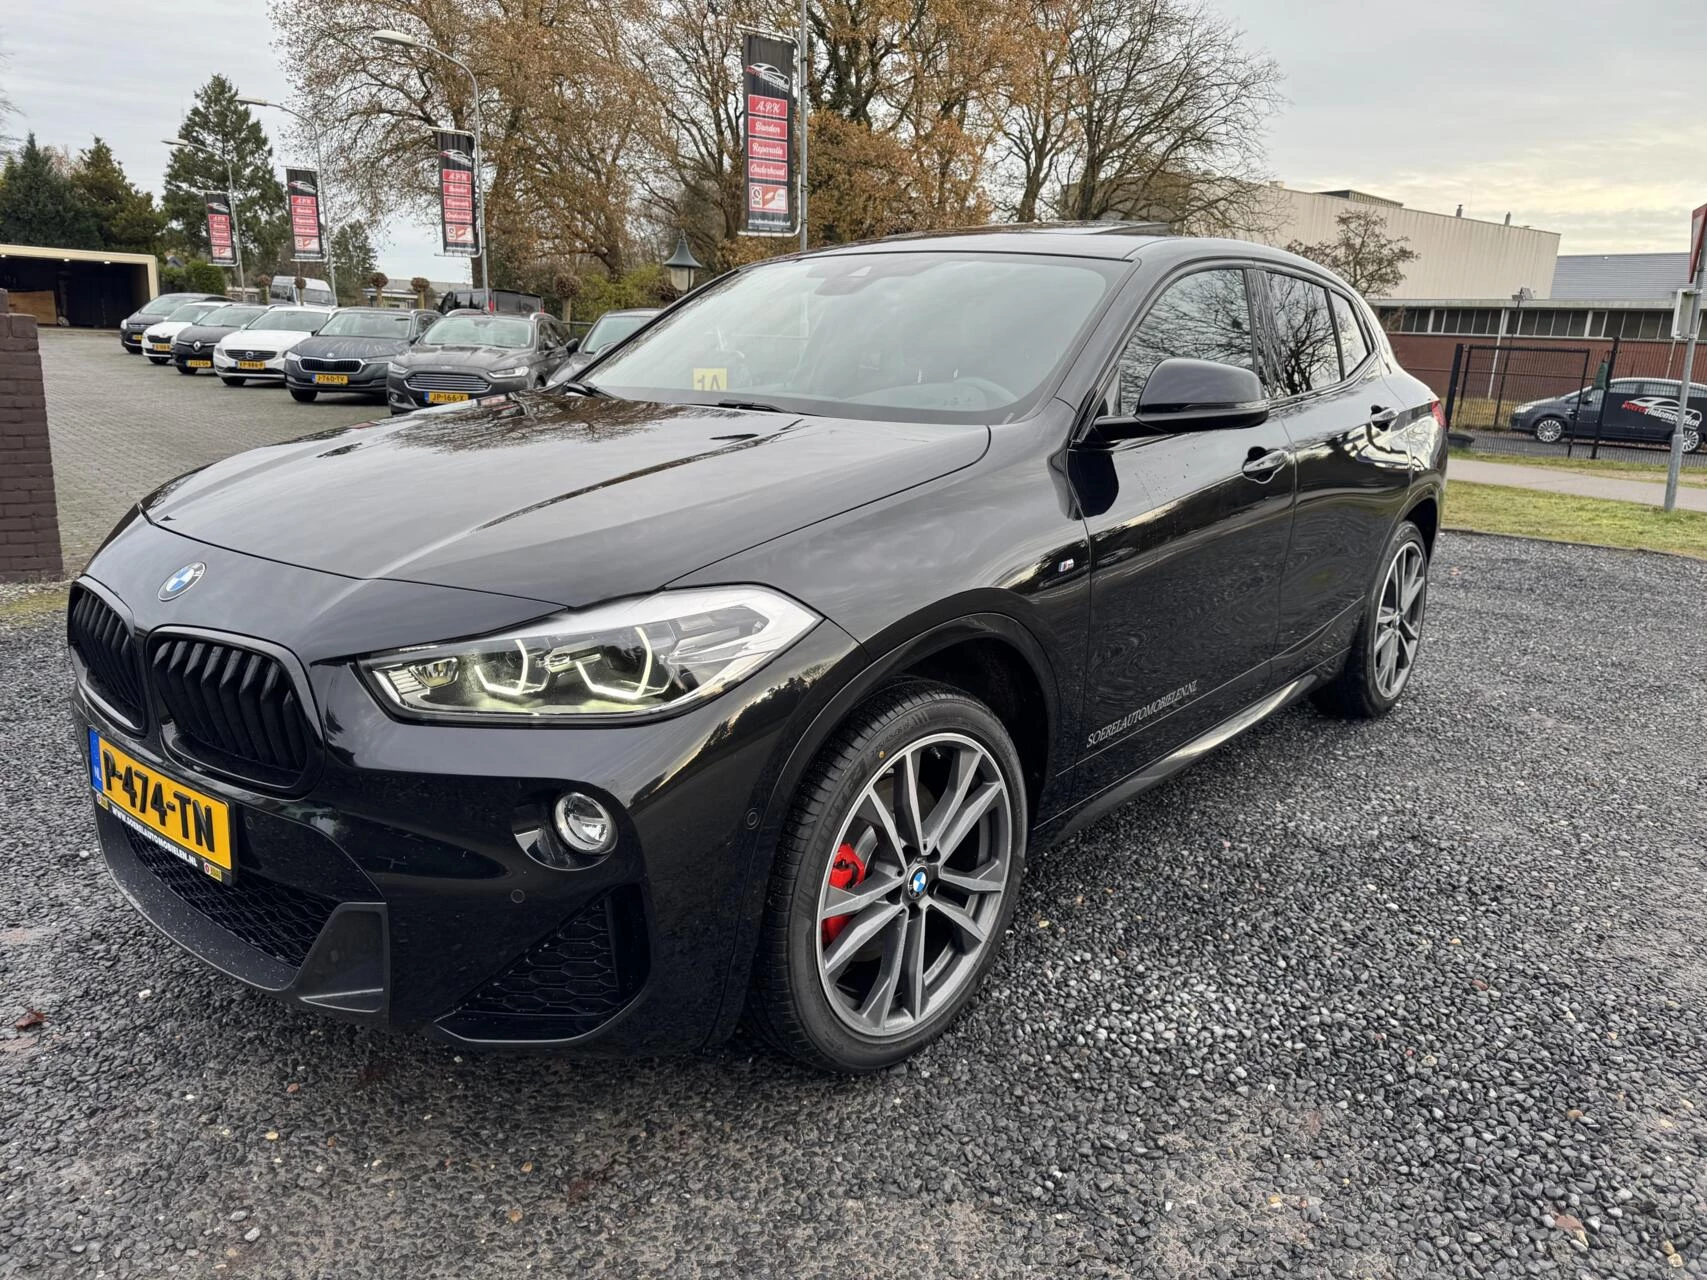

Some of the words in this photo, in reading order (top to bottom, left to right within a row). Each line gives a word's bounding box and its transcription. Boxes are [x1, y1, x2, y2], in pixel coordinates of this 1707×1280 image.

[755, 121, 780, 134] Banden
[751, 164, 785, 176] Onderhoud
[103, 750, 215, 852] P-474-TN
